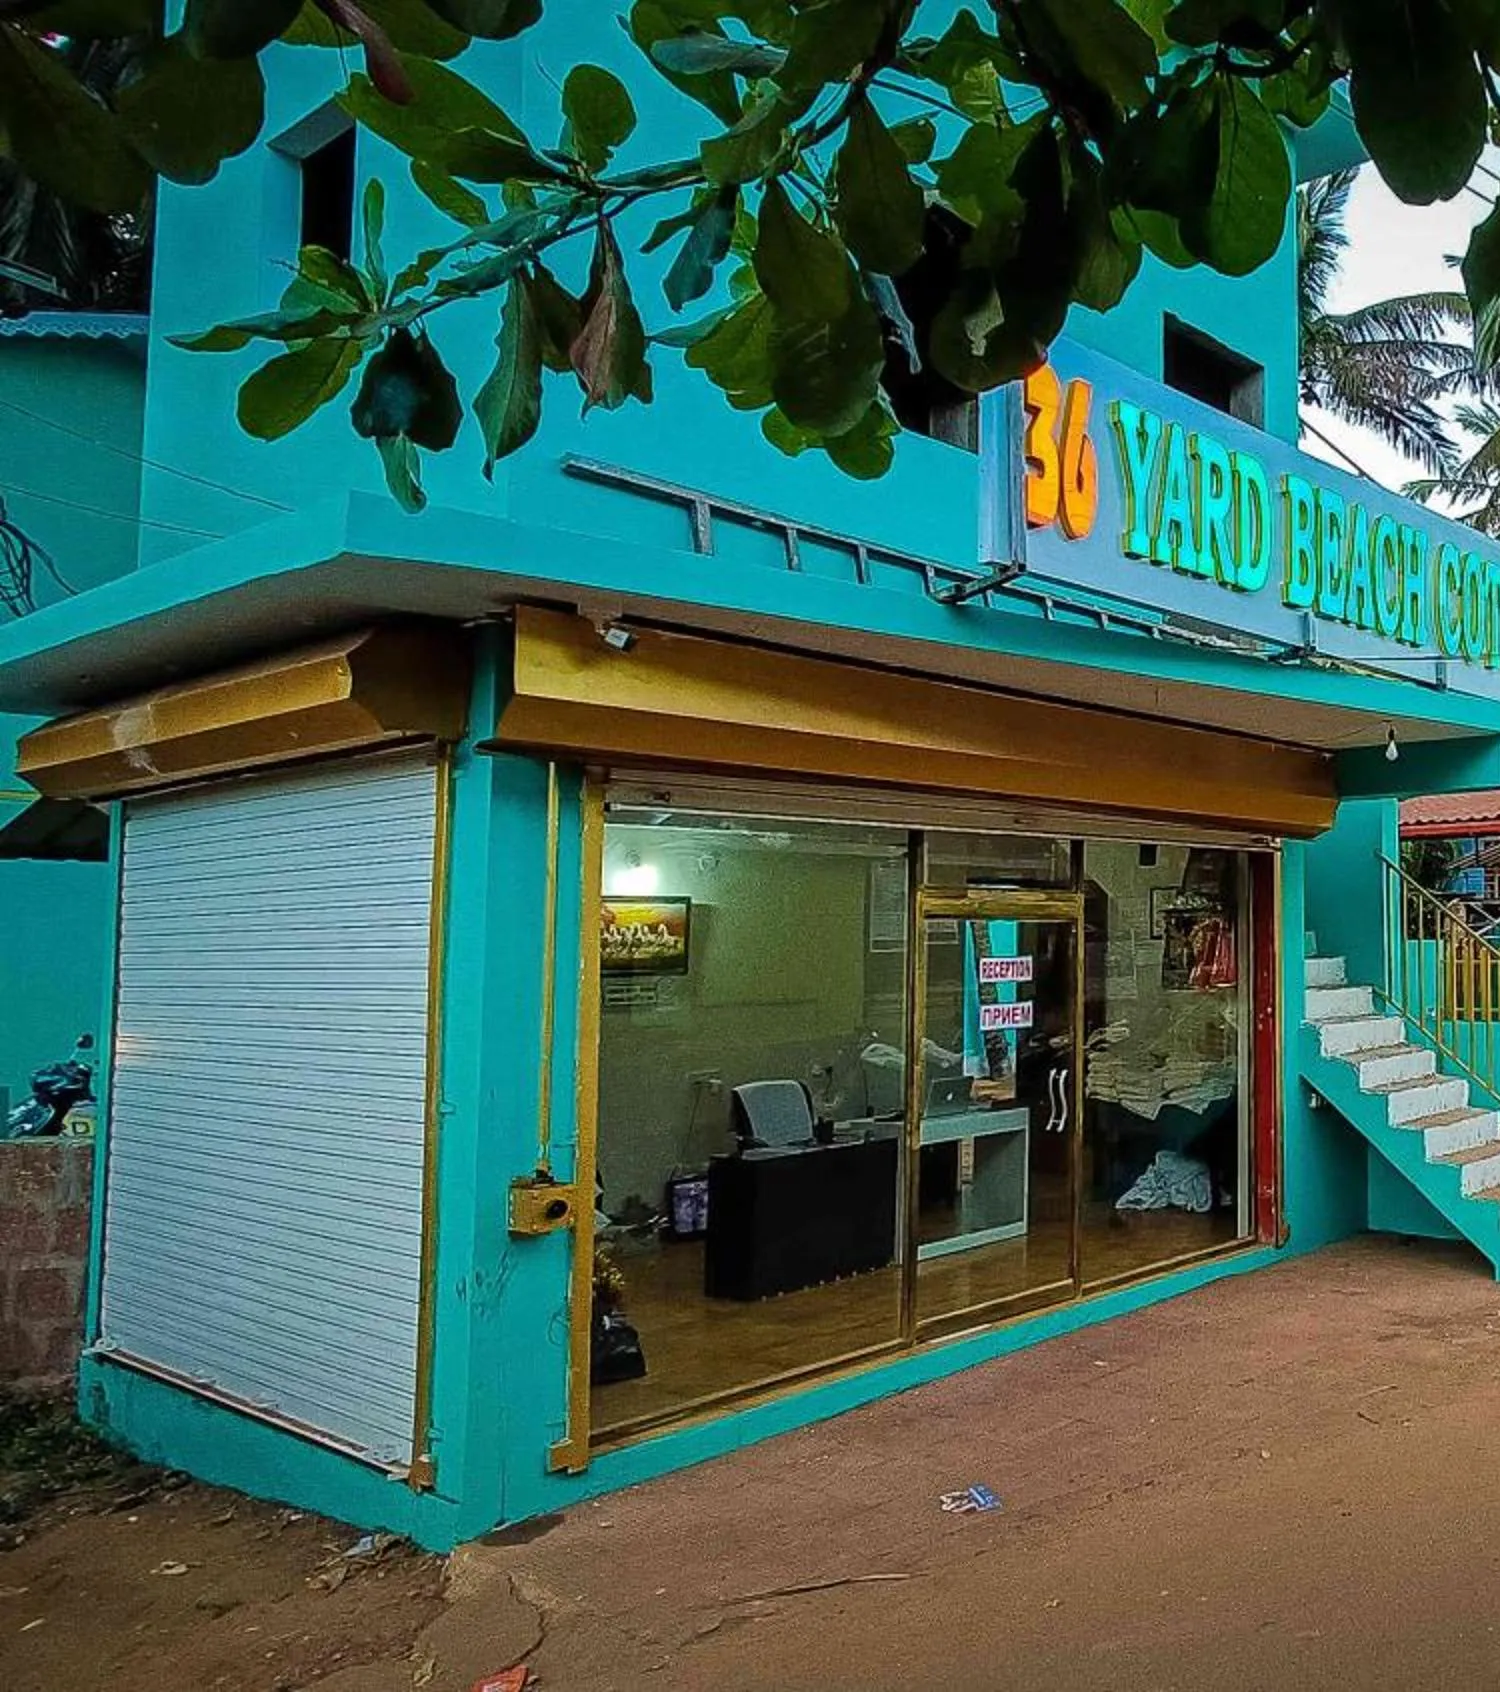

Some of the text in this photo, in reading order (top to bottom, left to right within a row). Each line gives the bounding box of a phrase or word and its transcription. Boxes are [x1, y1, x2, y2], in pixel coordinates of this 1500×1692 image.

[1024, 363, 1098, 540] 36
[1109, 400, 1271, 594] YARD
[1281, 474, 1428, 647] BEACH
[982, 959, 1031, 978] RECEPTION
[983, 1005, 1030, 1026] ПРИЕМ
